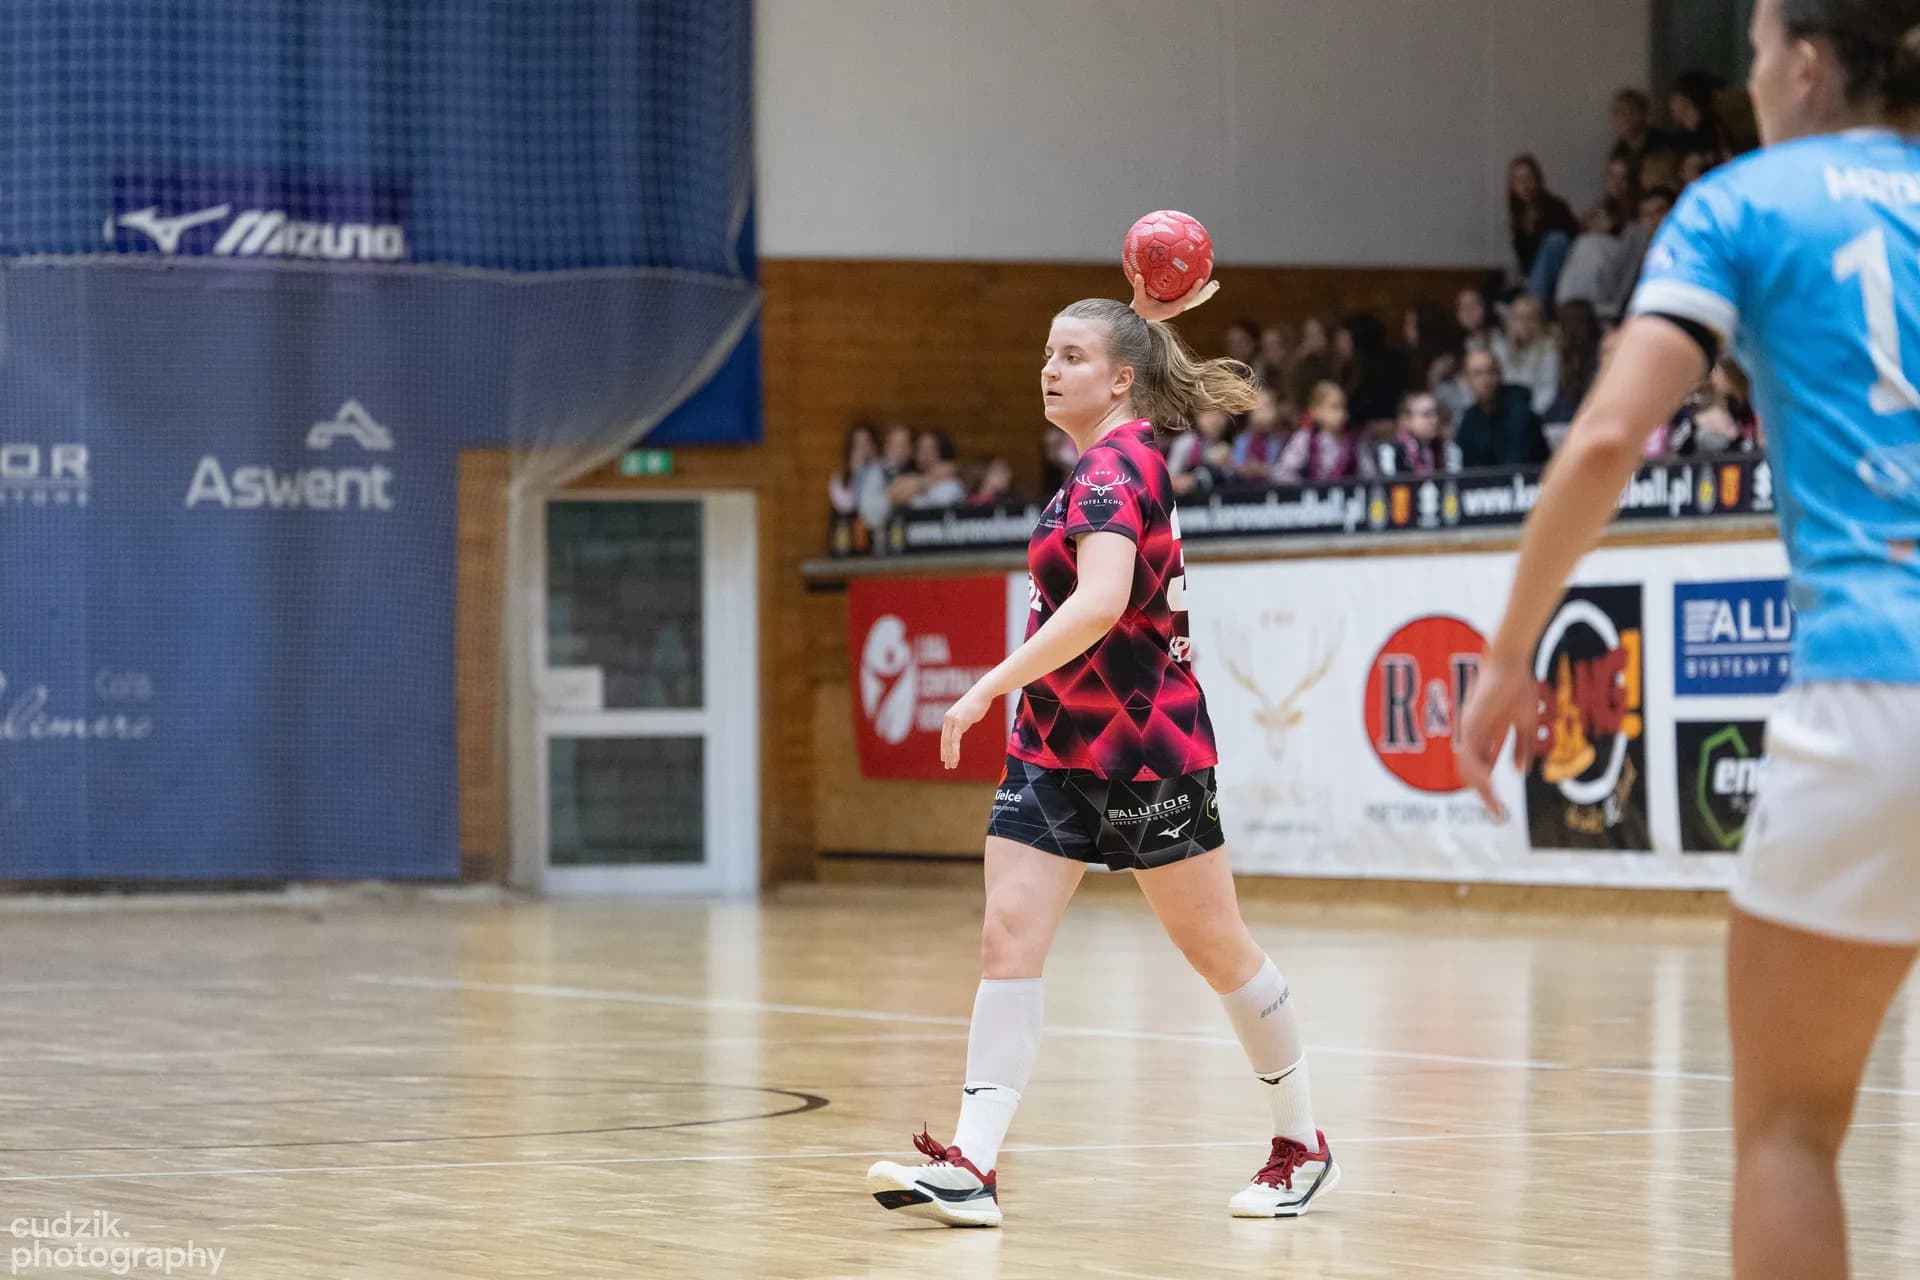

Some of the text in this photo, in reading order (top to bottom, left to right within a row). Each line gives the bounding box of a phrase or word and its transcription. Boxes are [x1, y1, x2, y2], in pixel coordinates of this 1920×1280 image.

[0, 444, 89, 479] OR
[186, 455, 396, 510] Aswent
[1712, 598, 1791, 641] ALU
[1714, 758, 1758, 794] en
[1118, 794, 1190, 818] ALUTOR
